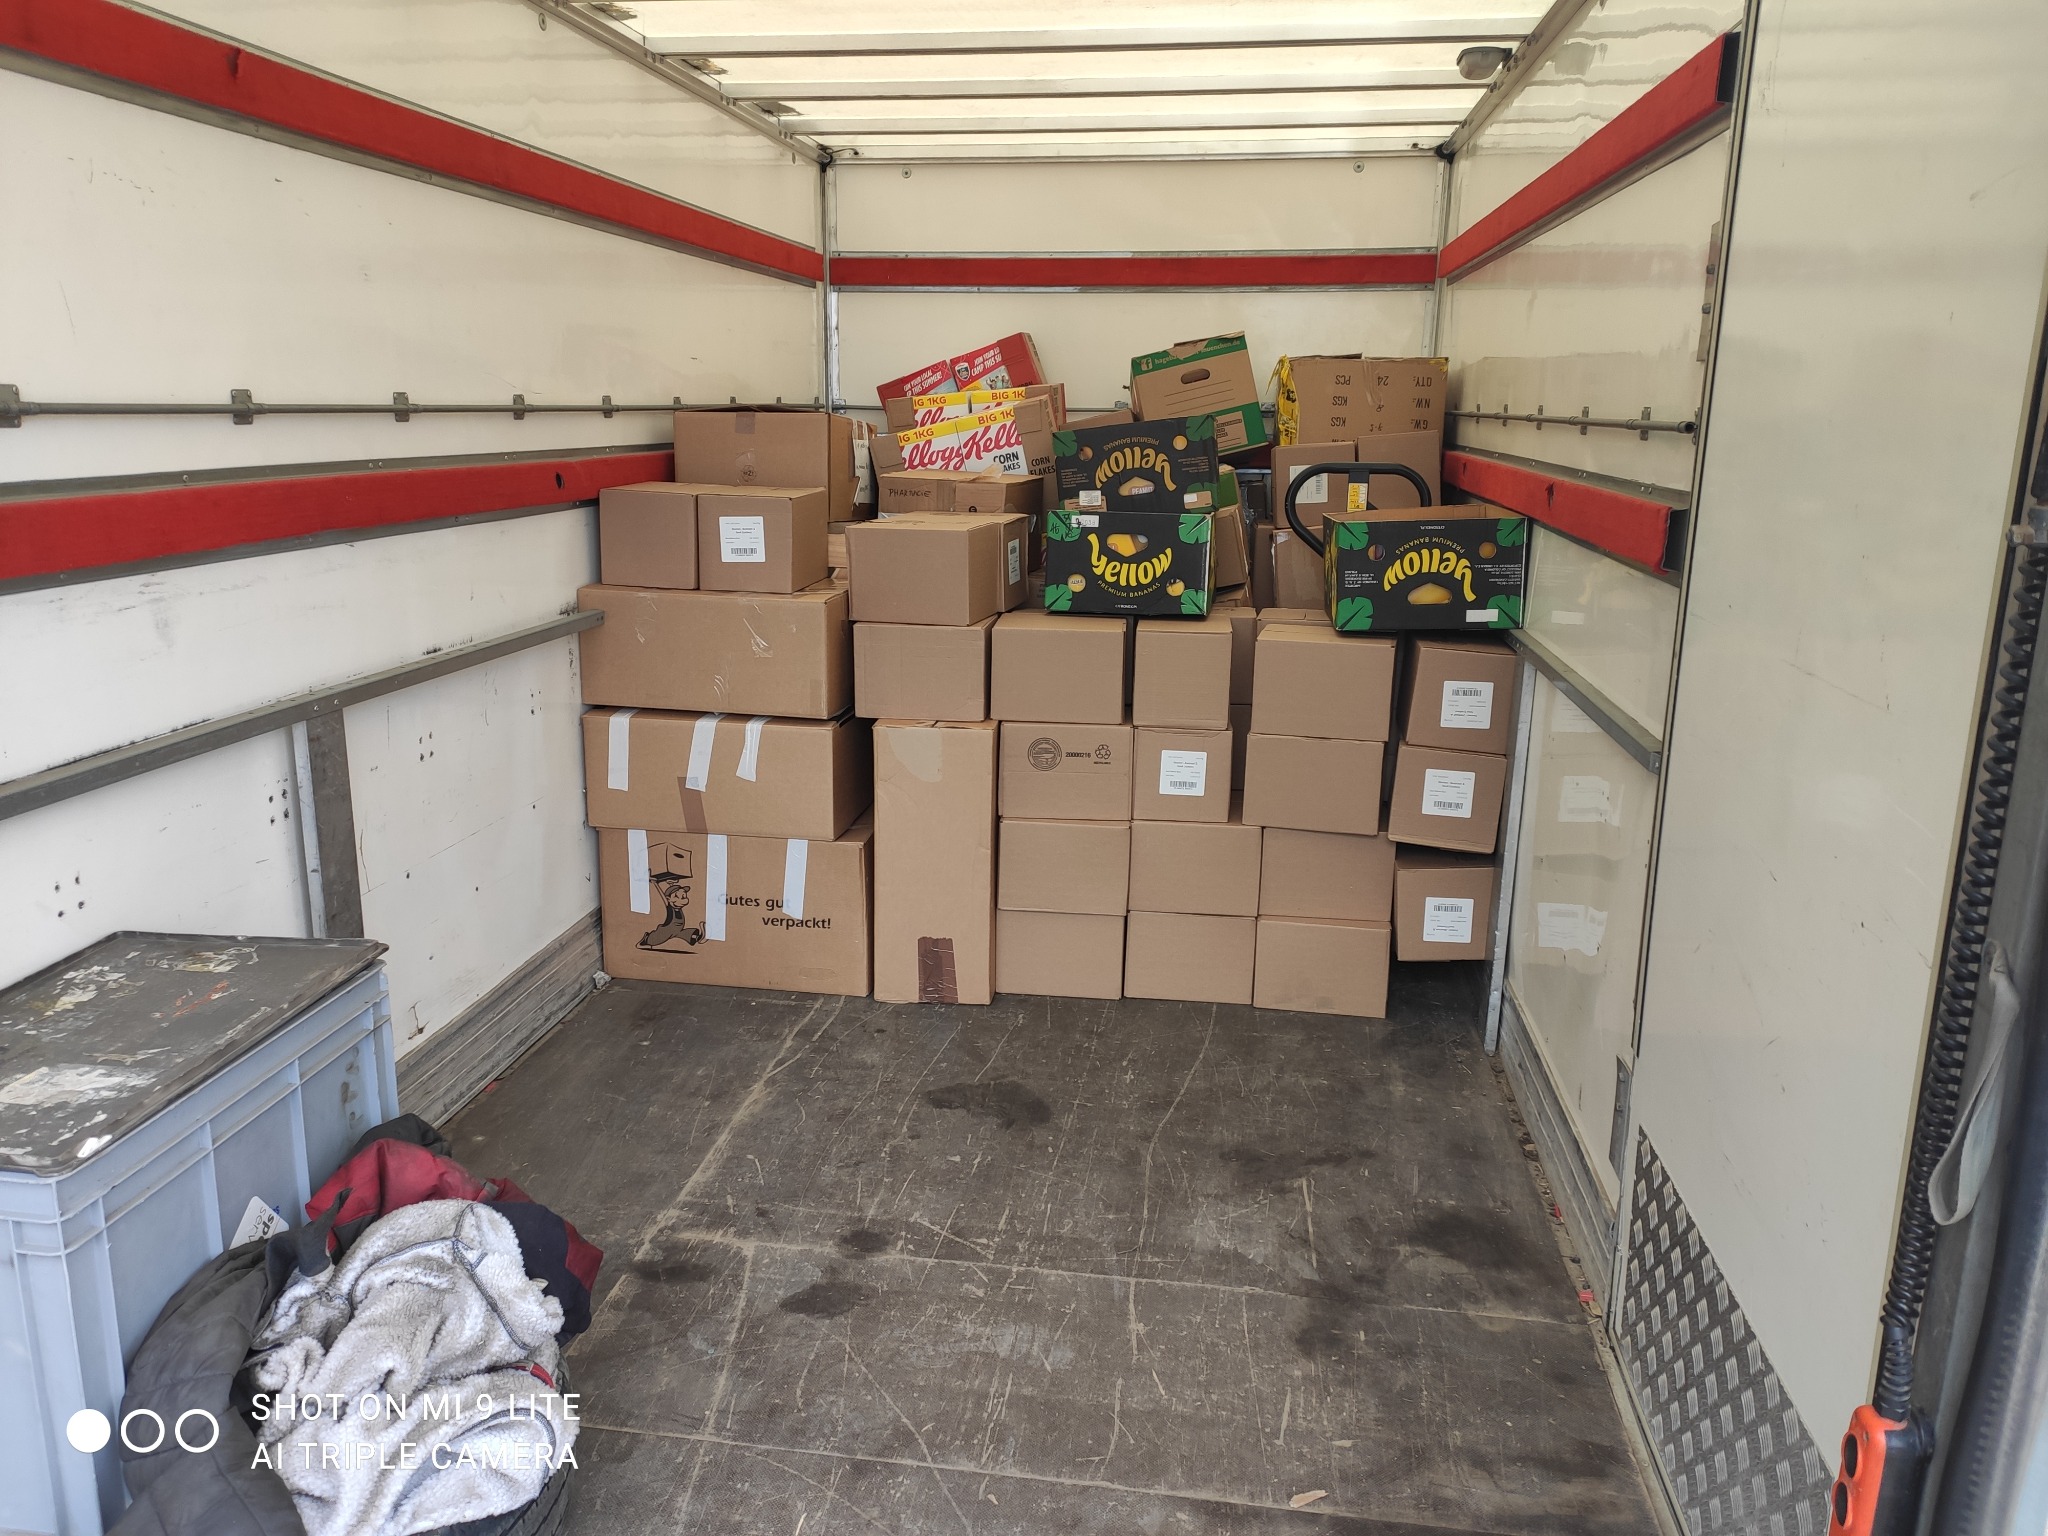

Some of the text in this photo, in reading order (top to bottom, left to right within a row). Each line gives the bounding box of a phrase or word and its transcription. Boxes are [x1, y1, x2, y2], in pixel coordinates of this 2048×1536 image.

[1335, 375, 1351, 386] PCS
[1377, 376, 1389, 386] 24
[914, 396, 946, 407] IG 1KG
[992, 390, 1025, 400] BIG 1K
[1332, 396, 1348, 406] KGS
[978, 408, 1014, 425] BIG 1K
[1331, 417, 1346, 427] KGS
[899, 428, 934, 443] IG 1KG
[1103, 436, 1160, 450] PREMIUM BANANAS
[1003, 462, 1021, 472] AKES
[1032, 456, 1050, 467] CORN
[1095, 446, 1177, 492] yellow
[1396, 536, 1466, 555] PREMIUM BANANAS
[1087, 532, 1172, 587] yellow
[1383, 548, 1477, 602] yellow
[1097, 579, 1161, 598] PREMIUM BANANAS
[762, 917, 831, 930] verpackt!
